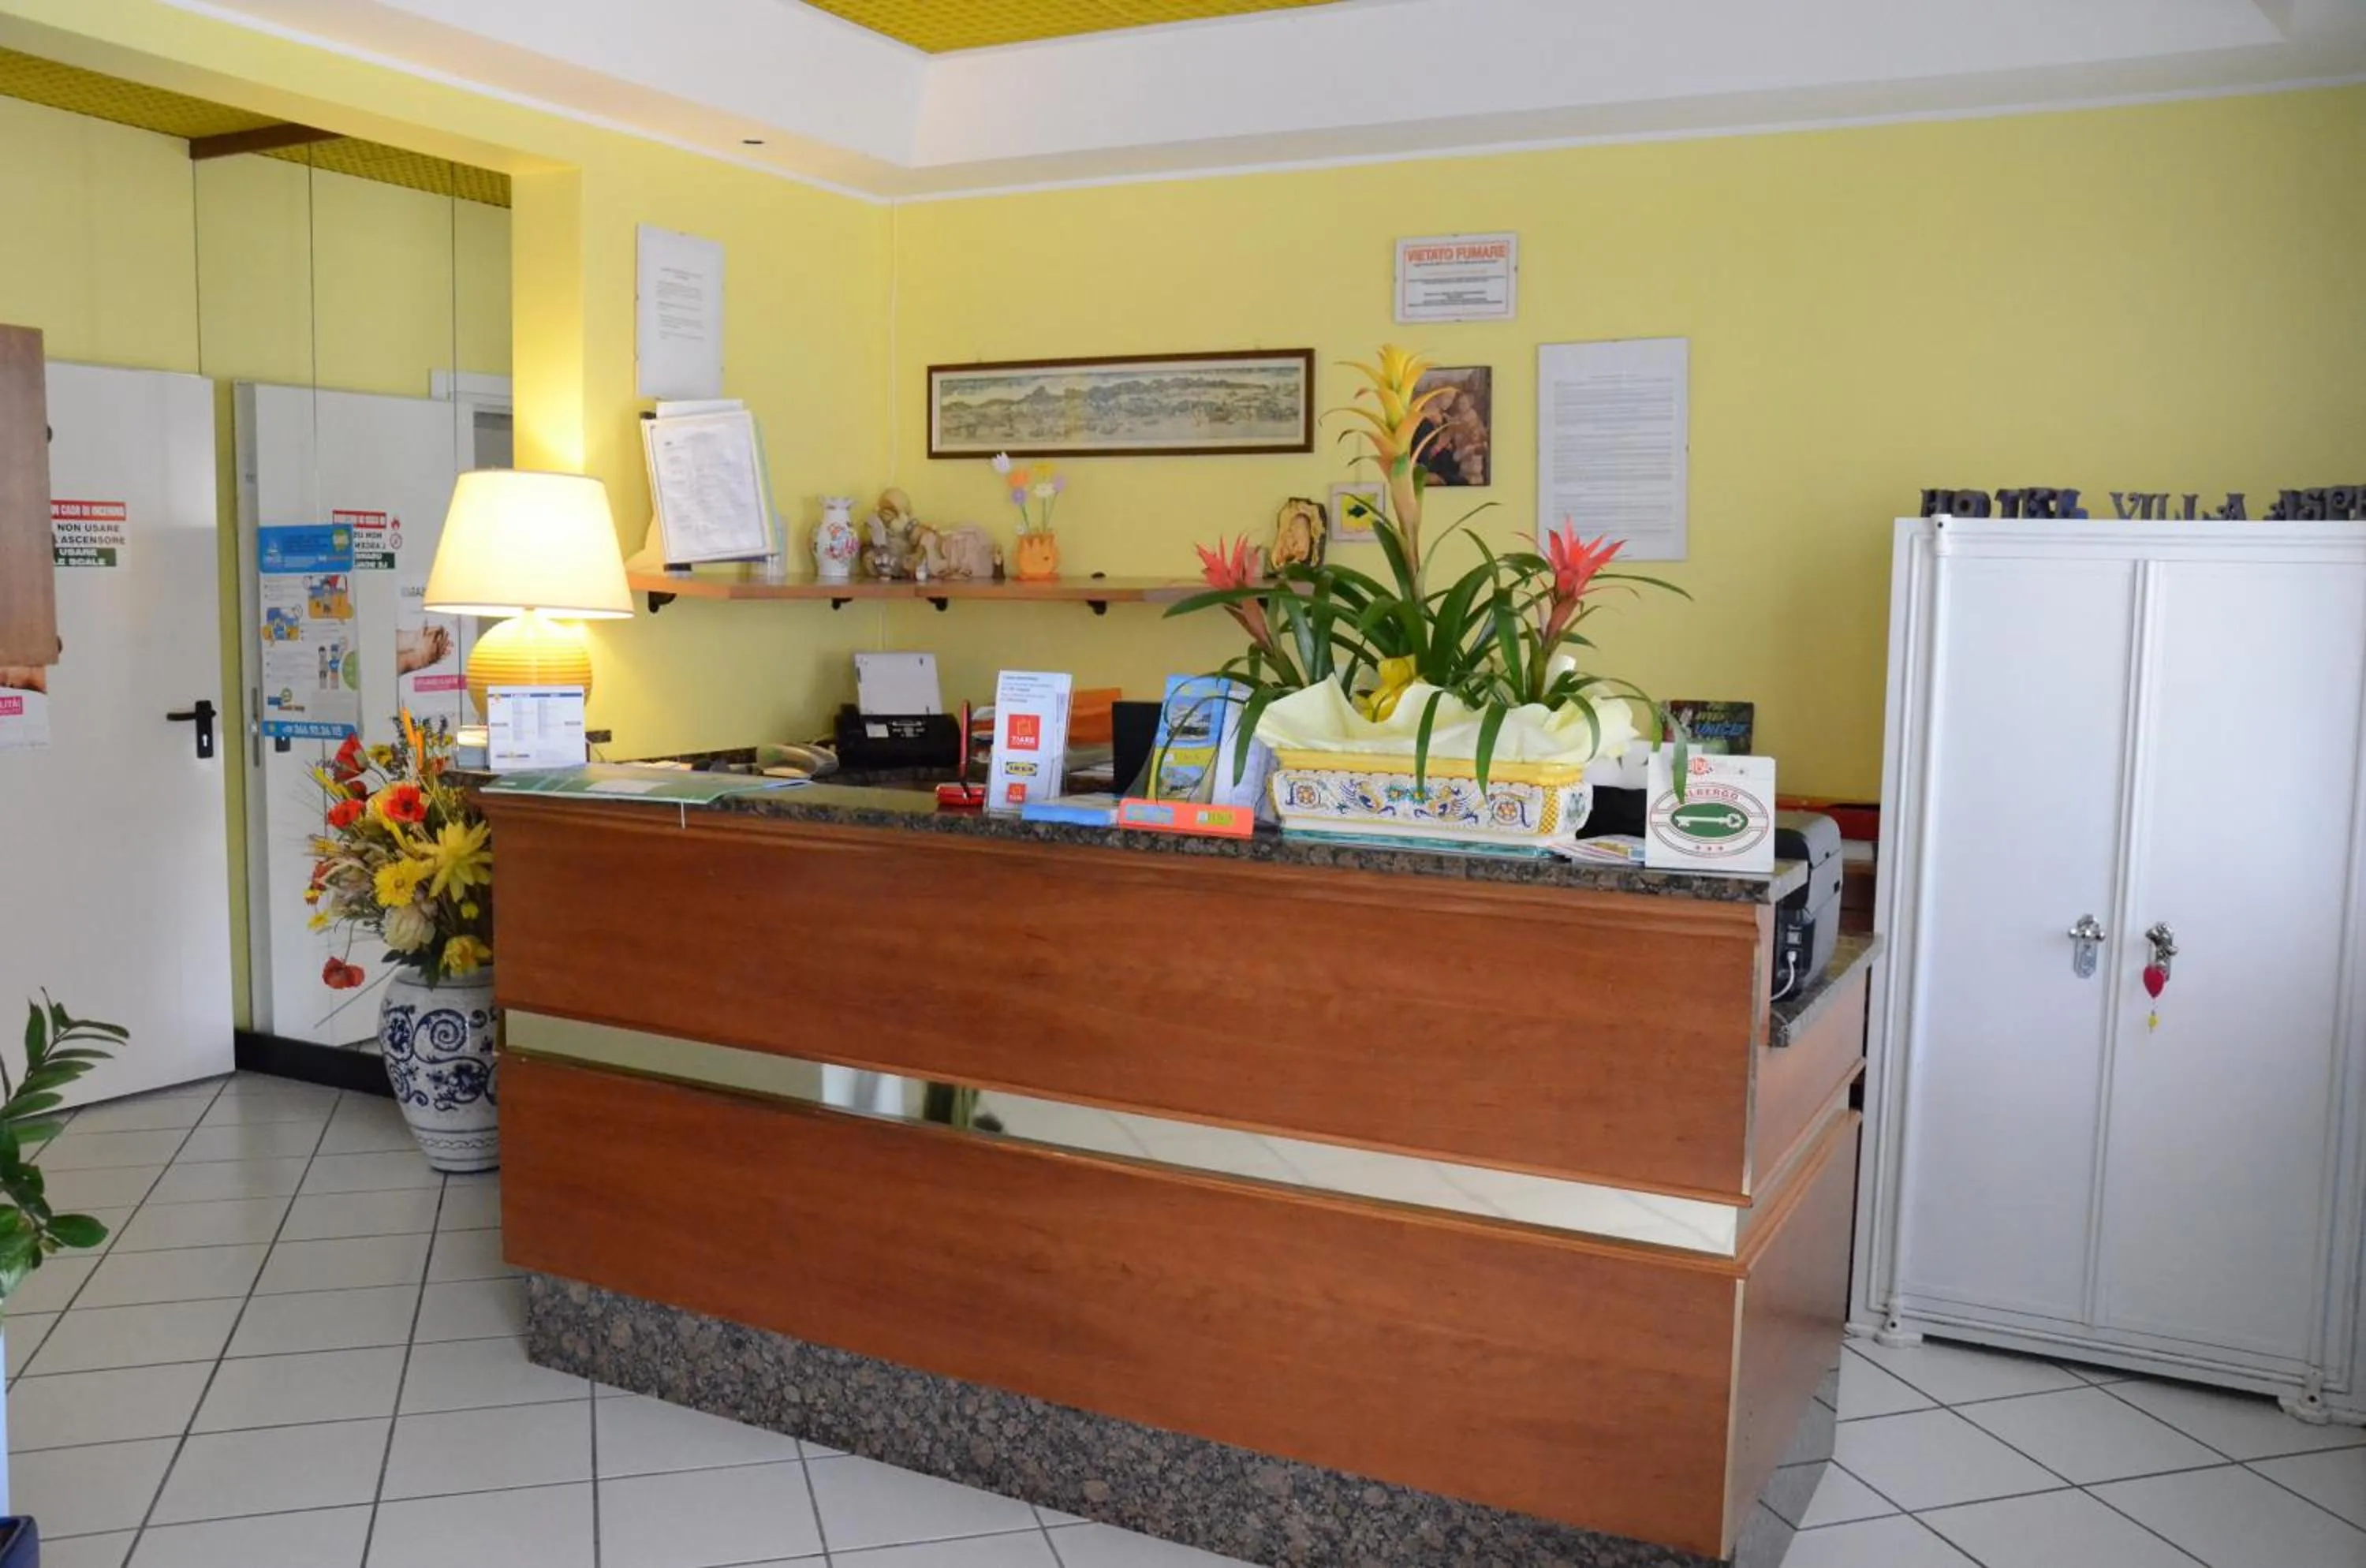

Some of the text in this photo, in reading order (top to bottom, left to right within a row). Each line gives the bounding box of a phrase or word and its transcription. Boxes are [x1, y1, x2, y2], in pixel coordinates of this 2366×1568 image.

[1408, 245, 1506, 262] VIETATO FUMARE
[1920, 487, 2088, 518] HOTEL
[2108, 491, 2247, 520] VILLA
[84, 524, 120, 532] USARE
